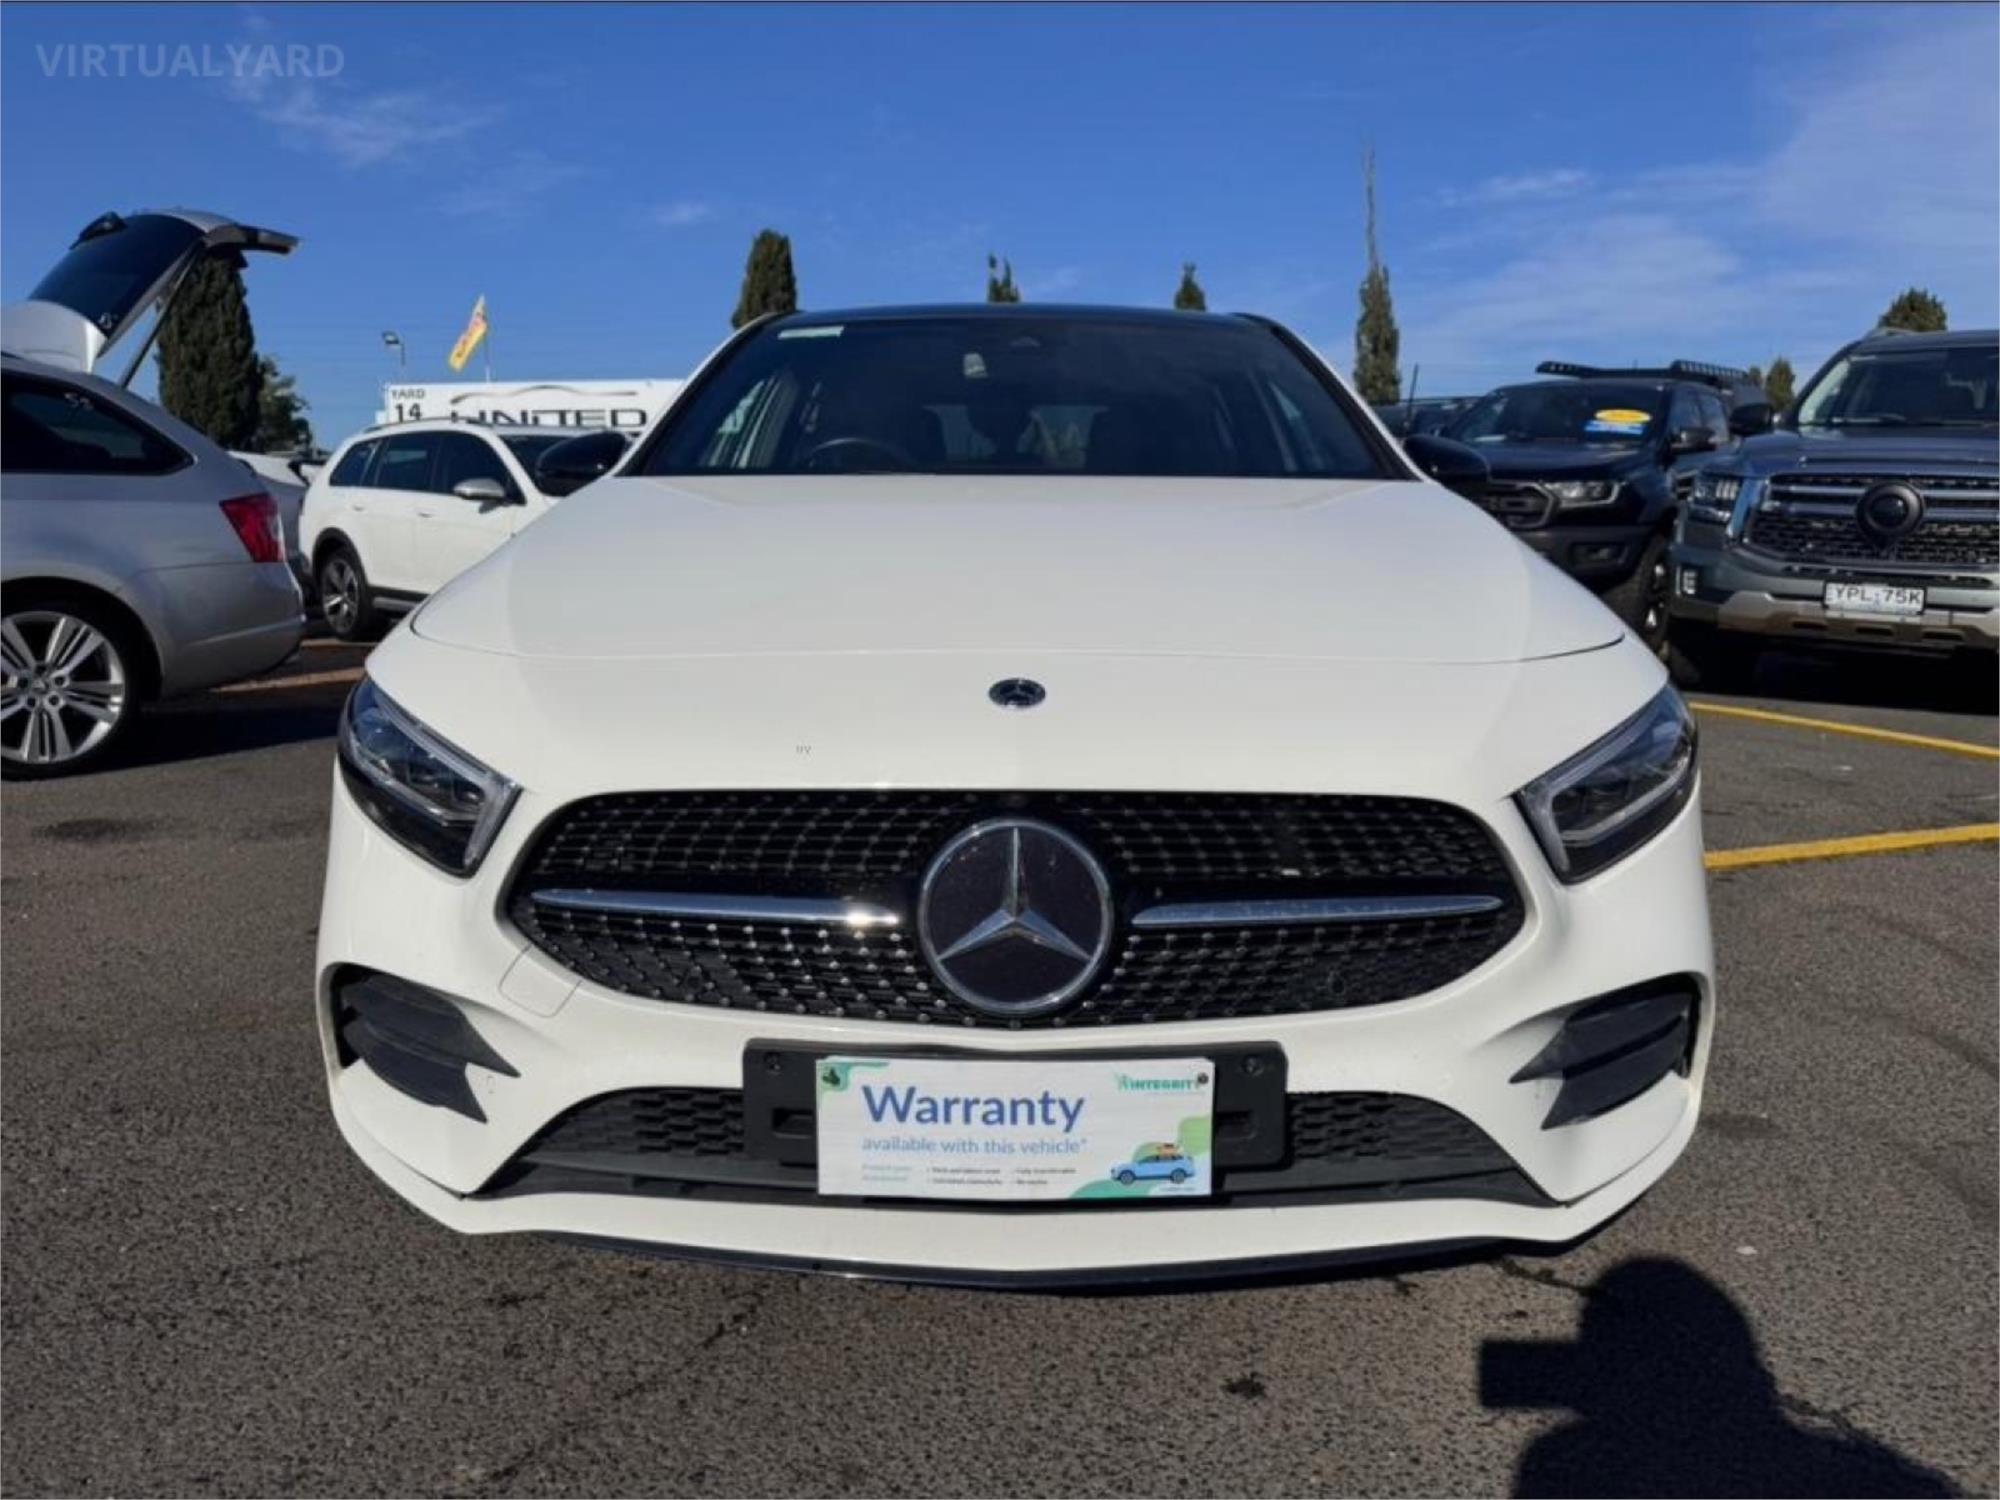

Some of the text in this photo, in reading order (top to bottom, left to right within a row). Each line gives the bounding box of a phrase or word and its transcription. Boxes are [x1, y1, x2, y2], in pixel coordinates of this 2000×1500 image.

[391, 389, 425, 399] YARD
[395, 403, 422, 422] 14
[450, 408, 648, 428] UNITED
[862, 1085, 1085, 1133] Warranty
[862, 1137, 936, 1151] available
[940, 1138, 979, 1153] with
[983, 1138, 1015, 1154] this
